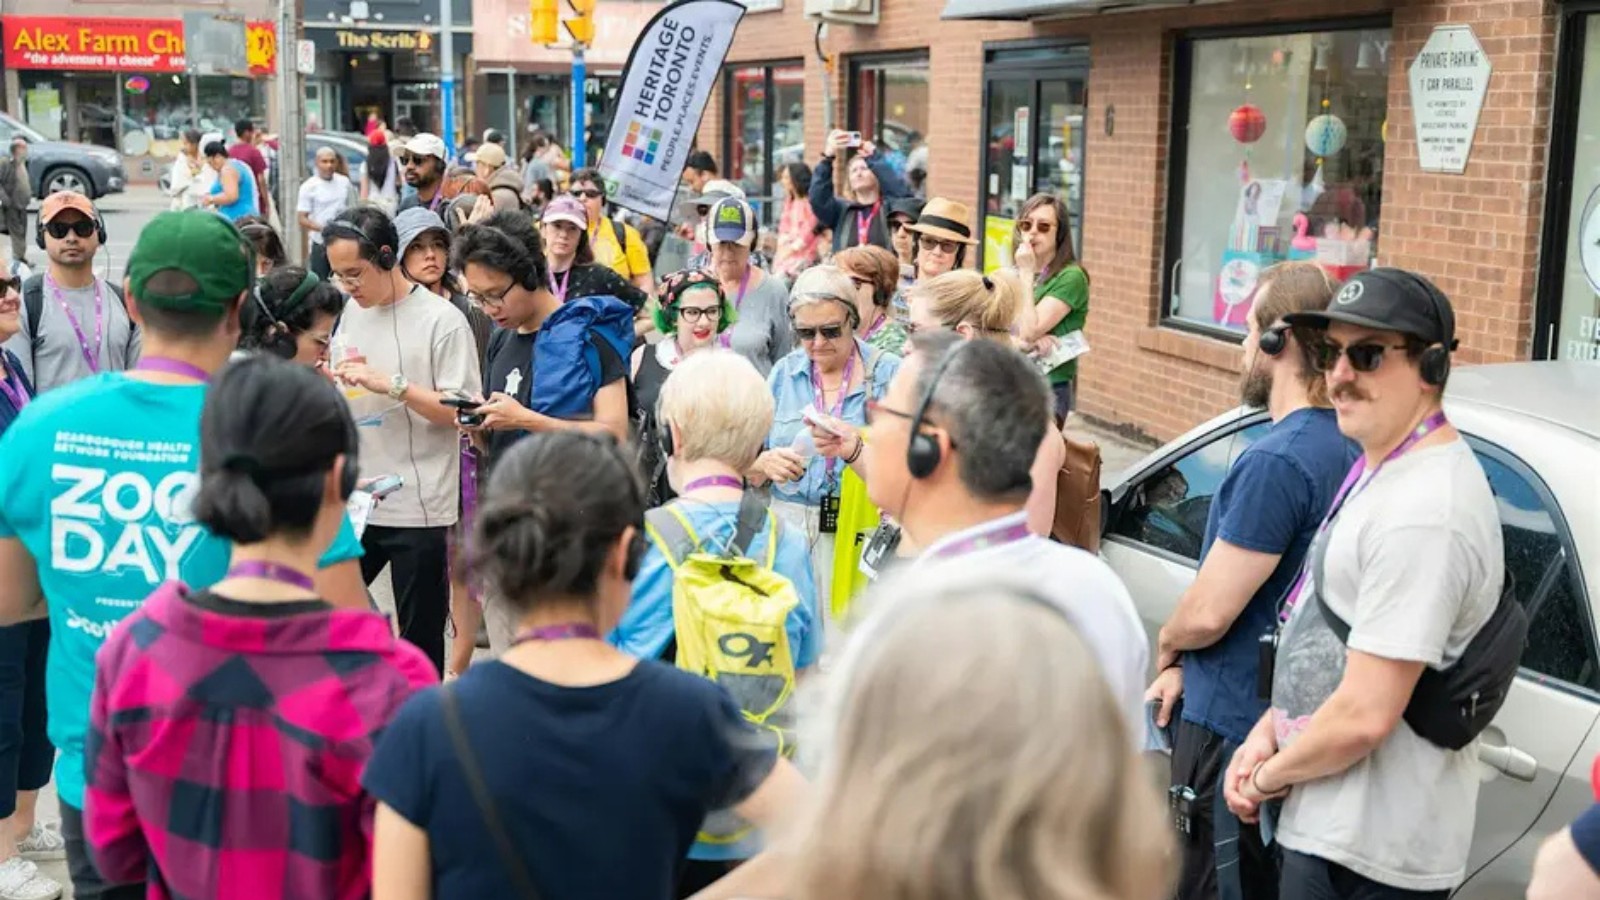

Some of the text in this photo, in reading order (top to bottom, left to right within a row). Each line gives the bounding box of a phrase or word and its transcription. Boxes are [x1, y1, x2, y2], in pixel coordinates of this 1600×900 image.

[13, 27, 186, 54] Alex Farm Ch
[335, 31, 418, 48] The Scrib
[51, 53, 103, 66] adventure
[106, 54, 117, 66] in
[634, 17, 680, 118] HERITAGE
[1420, 50, 1479, 68] PRIVATE PARKING
[653, 26, 695, 122] TORONTO
[1427, 78, 1440, 91] CAR
[1442, 77, 1473, 91] PARALLEL
[55, 431, 192, 453] SCARBOROUGH HEALTH
[54, 443, 189, 464] NETWORK FOUNDATION
[51, 517, 202, 584] DAY
[95, 597, 144, 608] PRESENT
[66, 607, 119, 638] Scot
